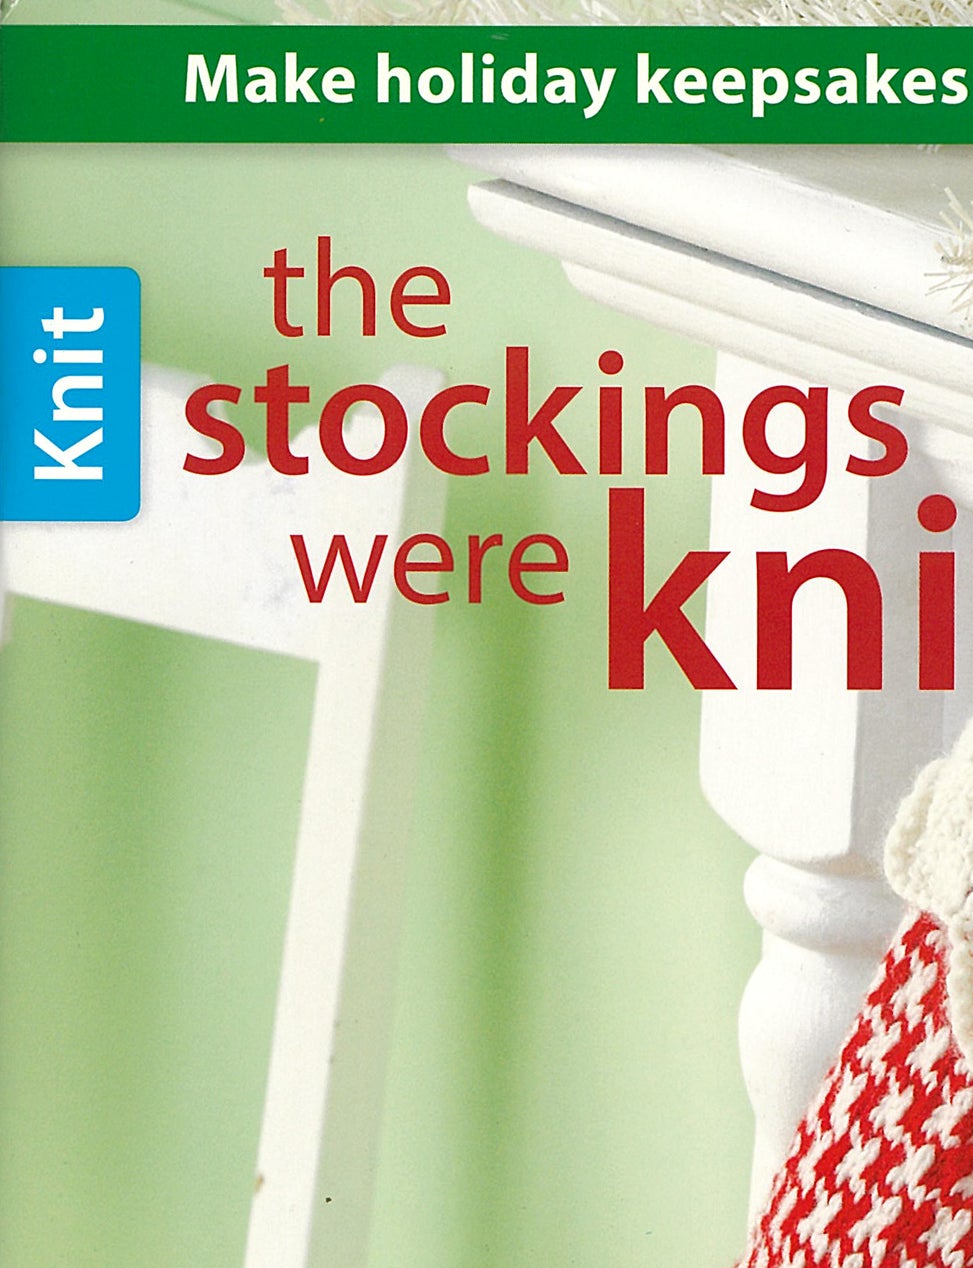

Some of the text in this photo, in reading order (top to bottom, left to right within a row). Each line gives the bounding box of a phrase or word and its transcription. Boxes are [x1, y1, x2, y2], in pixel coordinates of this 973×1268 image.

[185, 53, 355, 105] Make
[378, 53, 616, 119] holiday
[636, 53, 968, 117] keepsakes
[263, 236, 452, 338] the
[33, 306, 104, 481] Knit
[182, 346, 909, 512] stockings
[290, 533, 569, 604] were
